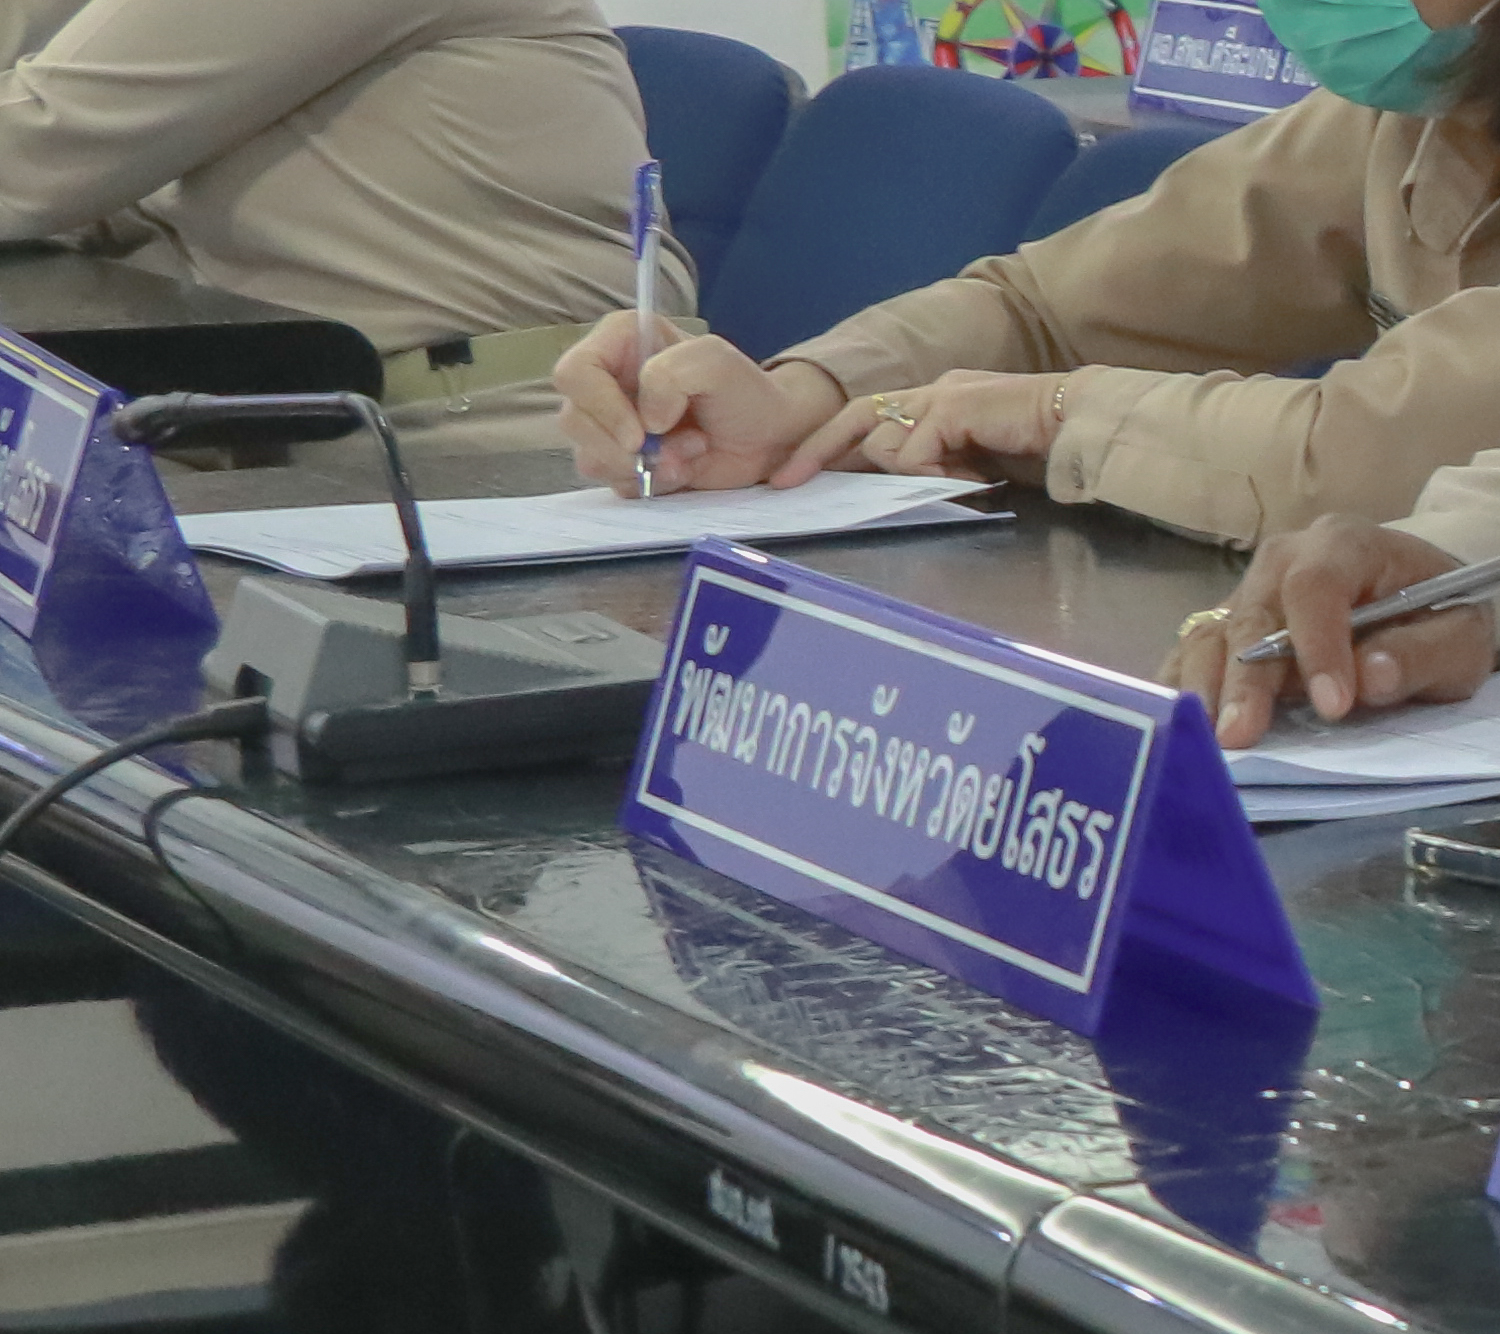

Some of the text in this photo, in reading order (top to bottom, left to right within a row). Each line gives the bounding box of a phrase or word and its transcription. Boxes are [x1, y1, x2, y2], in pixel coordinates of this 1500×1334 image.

[671, 622, 1116, 900] พัฒนาการจังหวัดยโสธร
